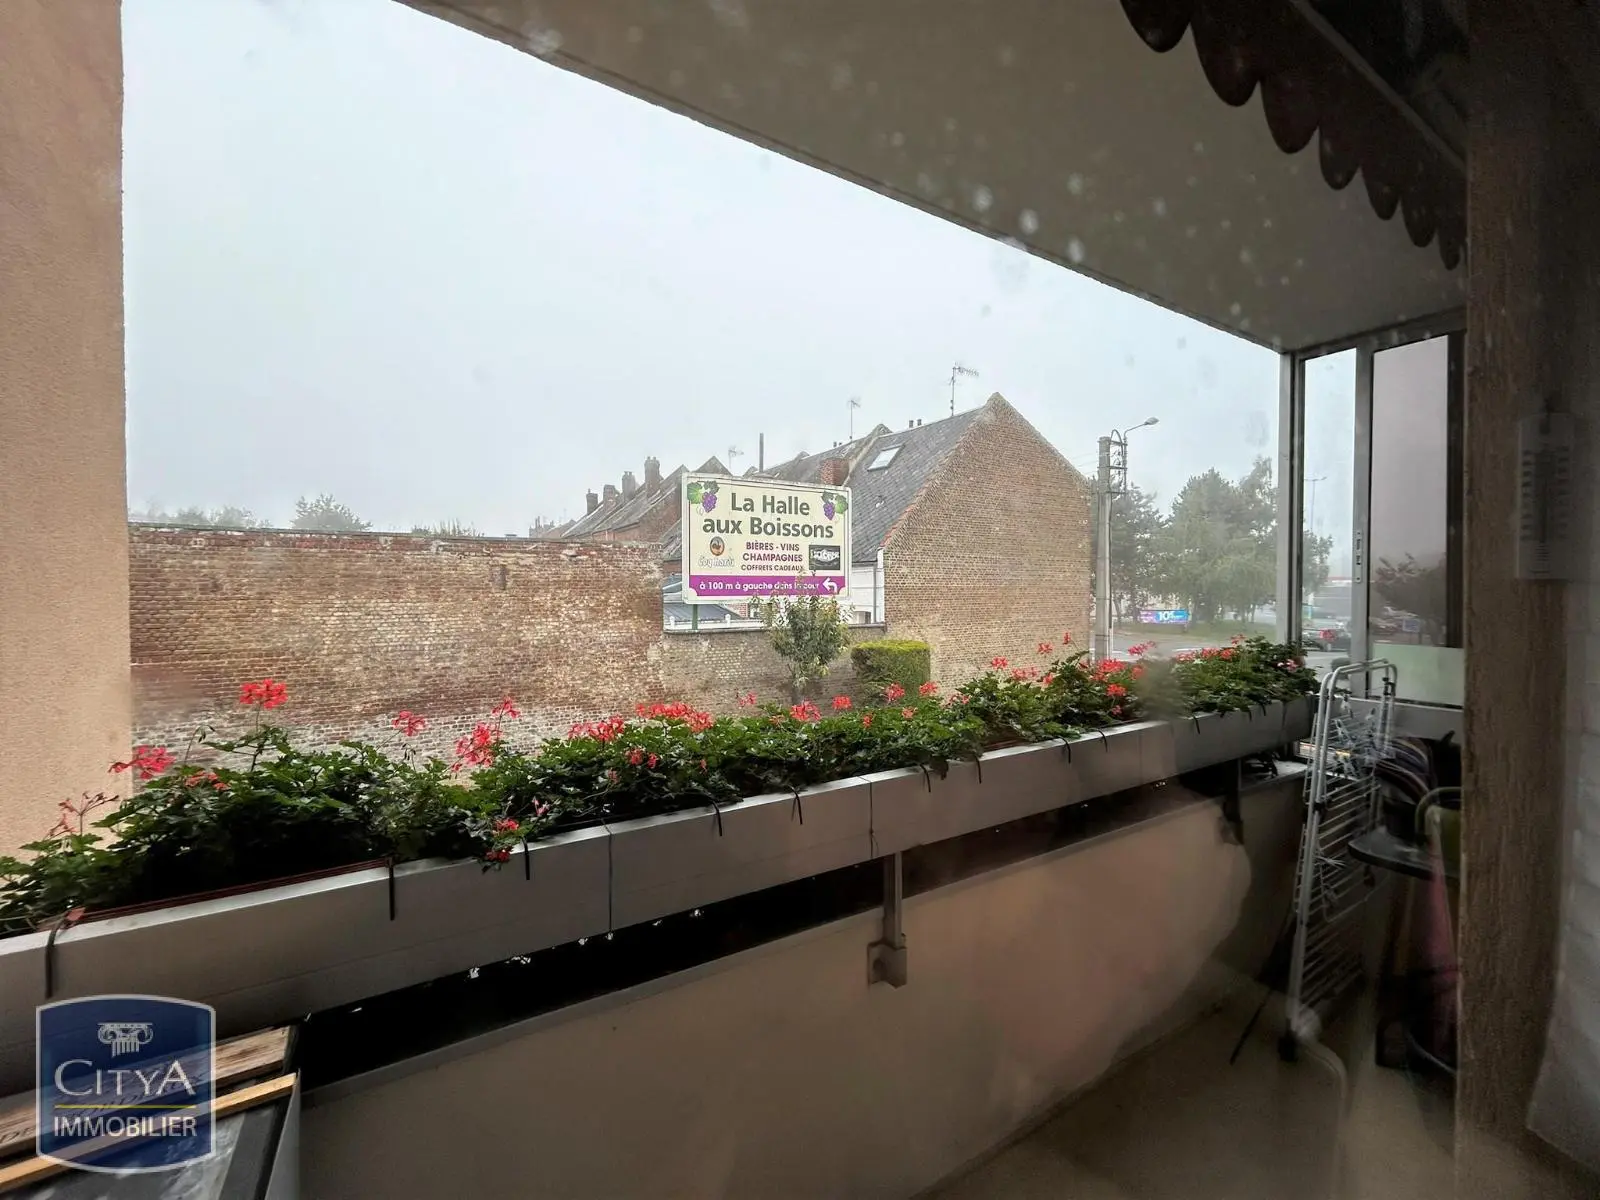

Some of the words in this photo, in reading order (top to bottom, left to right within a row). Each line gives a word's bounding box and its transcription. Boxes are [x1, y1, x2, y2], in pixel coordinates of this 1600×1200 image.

[731, 492, 755, 512] La
[762, 494, 810, 515] Halle
[702, 518, 743, 535] aux
[749, 517, 834, 539] Boissons
[745, 540, 774, 551] BIÈRES
[780, 543, 800, 552] VINS
[742, 552, 803, 562] CHAMPAGNES
[699, 581, 706, 590] à
[707, 581, 723, 590] 100
[735, 581, 741, 590] à
[743, 581, 773, 592] gauche
